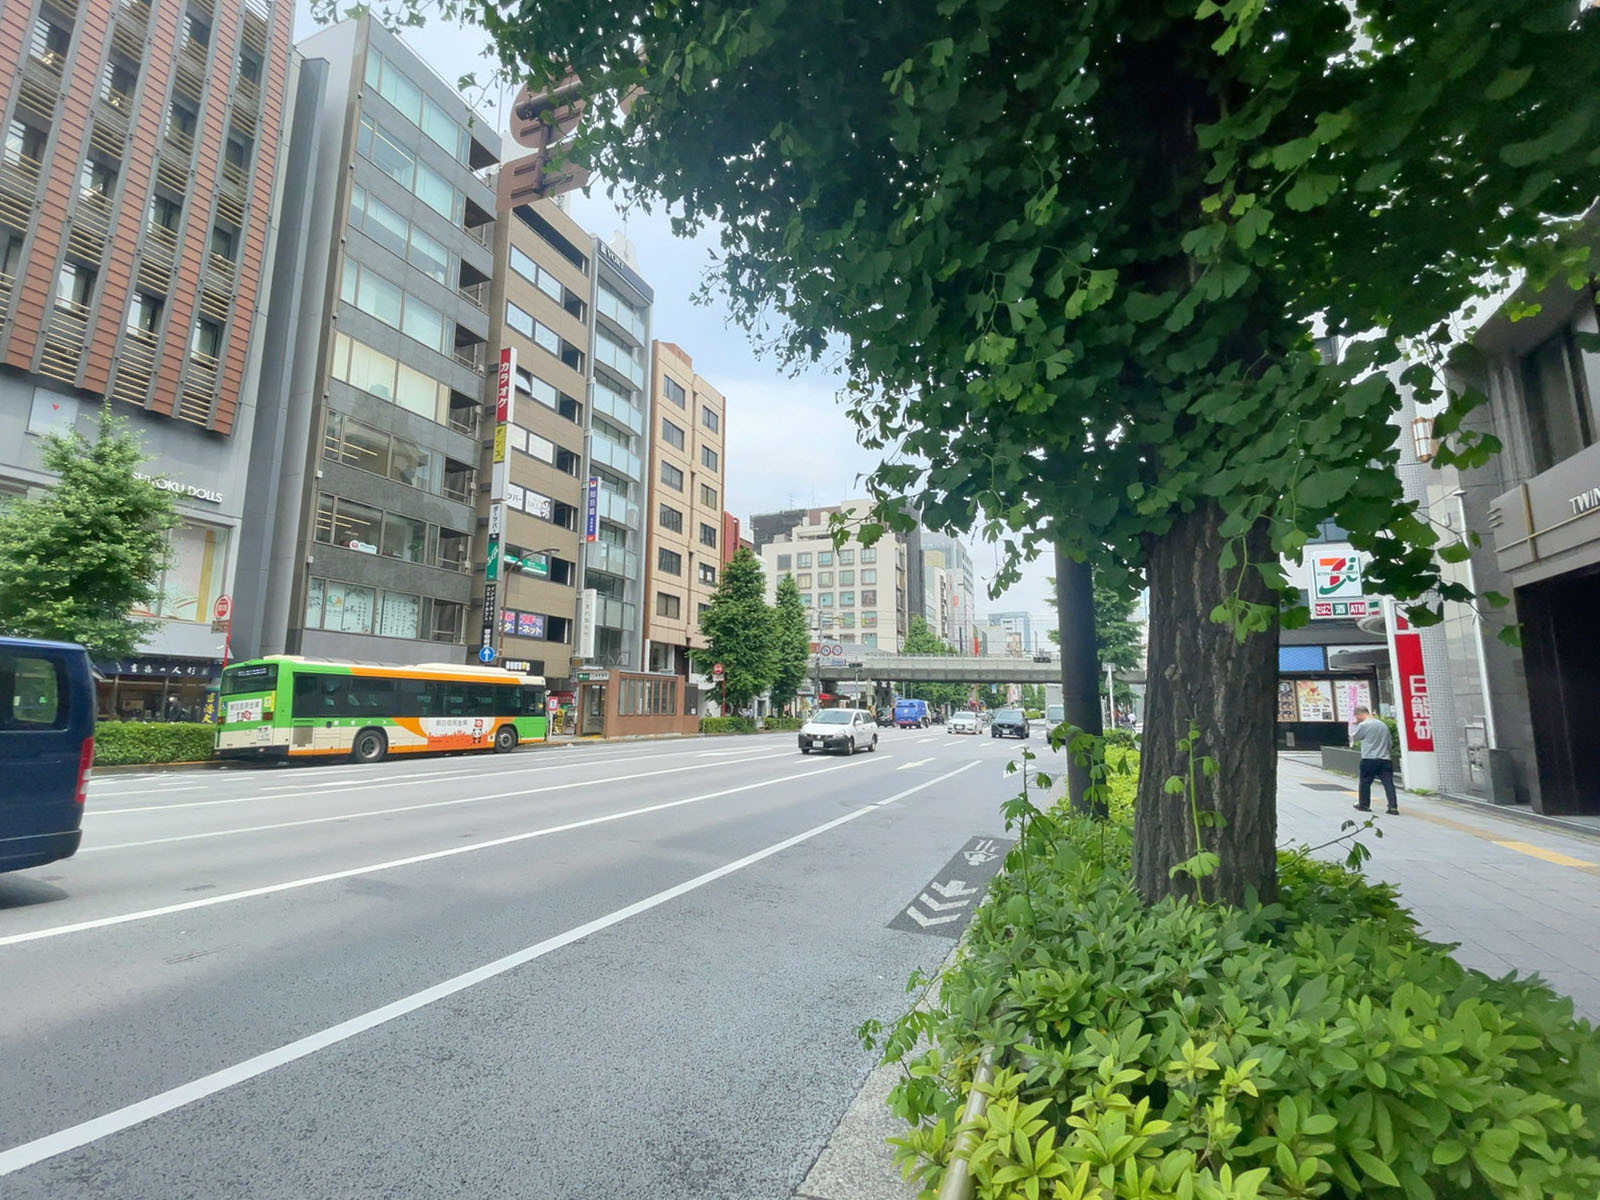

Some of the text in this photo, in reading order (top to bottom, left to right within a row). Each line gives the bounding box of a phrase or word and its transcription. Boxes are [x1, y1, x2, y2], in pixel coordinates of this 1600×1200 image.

[498, 362, 510, 408] カラオケ
[187, 485, 223, 503] DOLLS
[1334, 604, 1346, 614] 酒
[1350, 603, 1365, 613] ATM
[1409, 675, 1433, 740] 日能研
